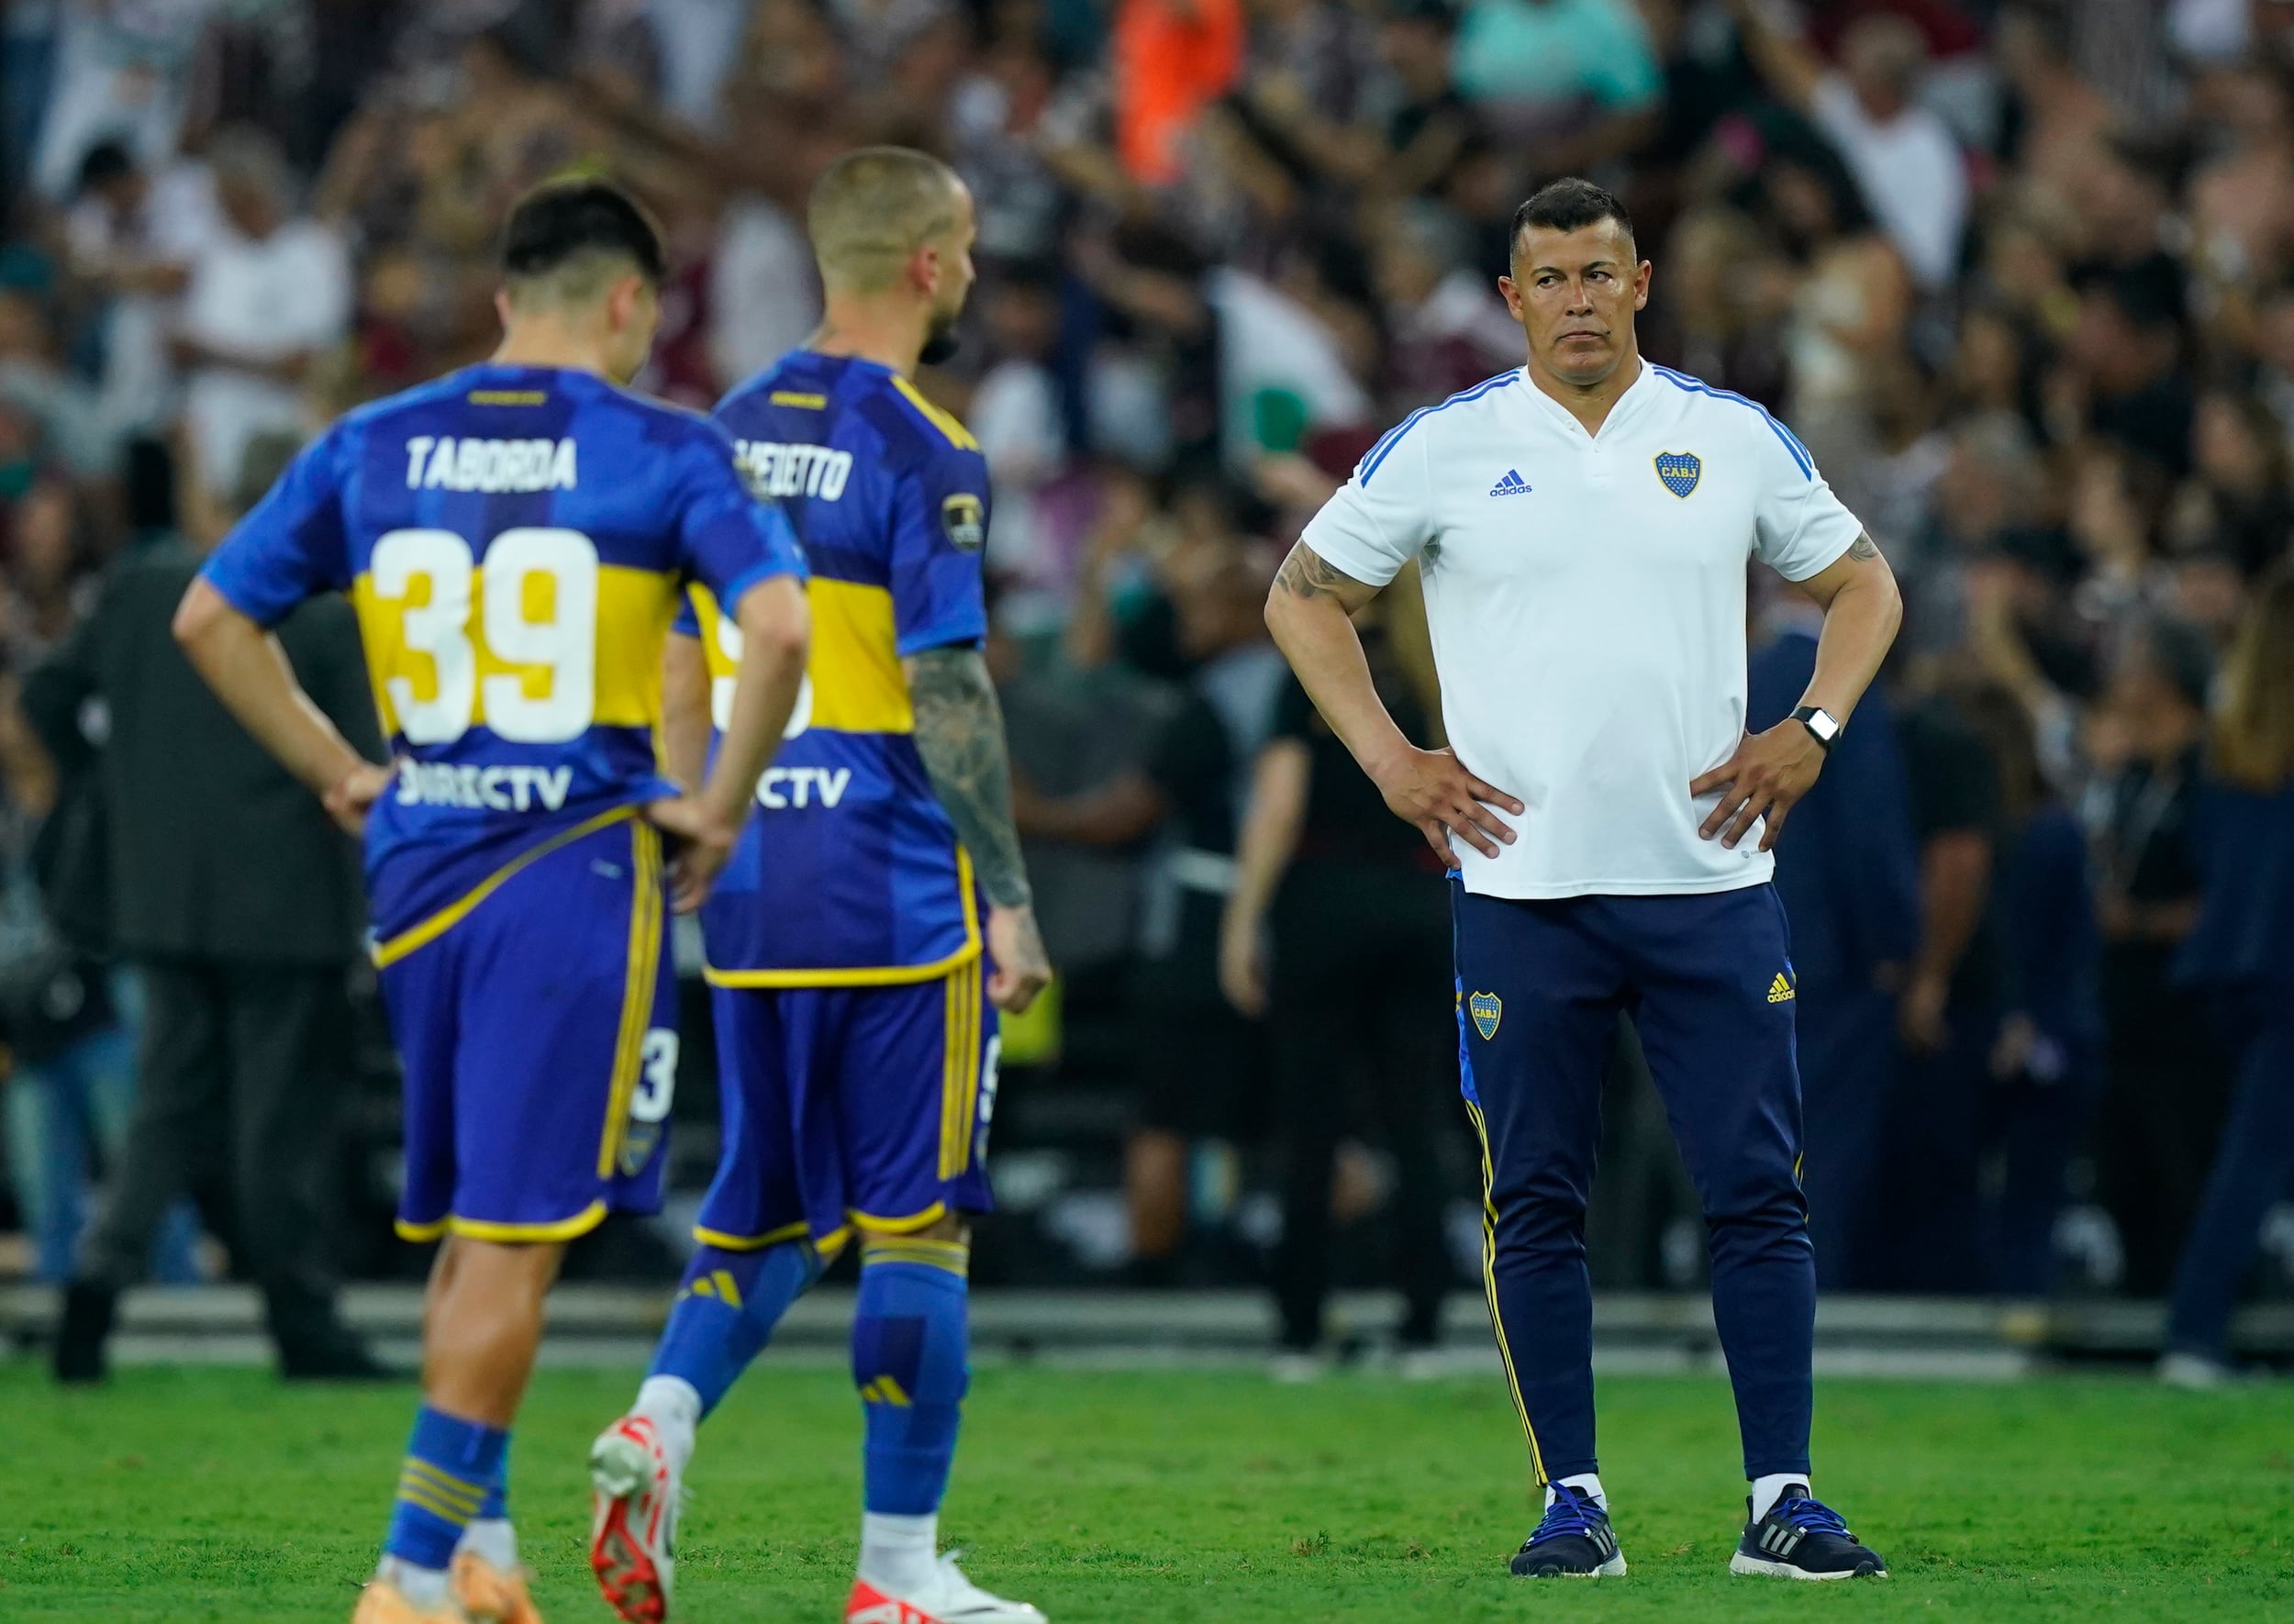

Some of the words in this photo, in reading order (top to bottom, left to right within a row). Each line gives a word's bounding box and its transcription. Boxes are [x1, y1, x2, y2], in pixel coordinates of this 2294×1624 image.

[406, 436, 577, 493] TABORDA
[1661, 466, 1697, 478] CABJ
[1489, 484, 1532, 496] adidas
[370, 527, 599, 744] 39
[751, 766, 852, 809] CTV
[1475, 1008, 1497, 1018] CABJ
[629, 1027, 680, 1123] 3
